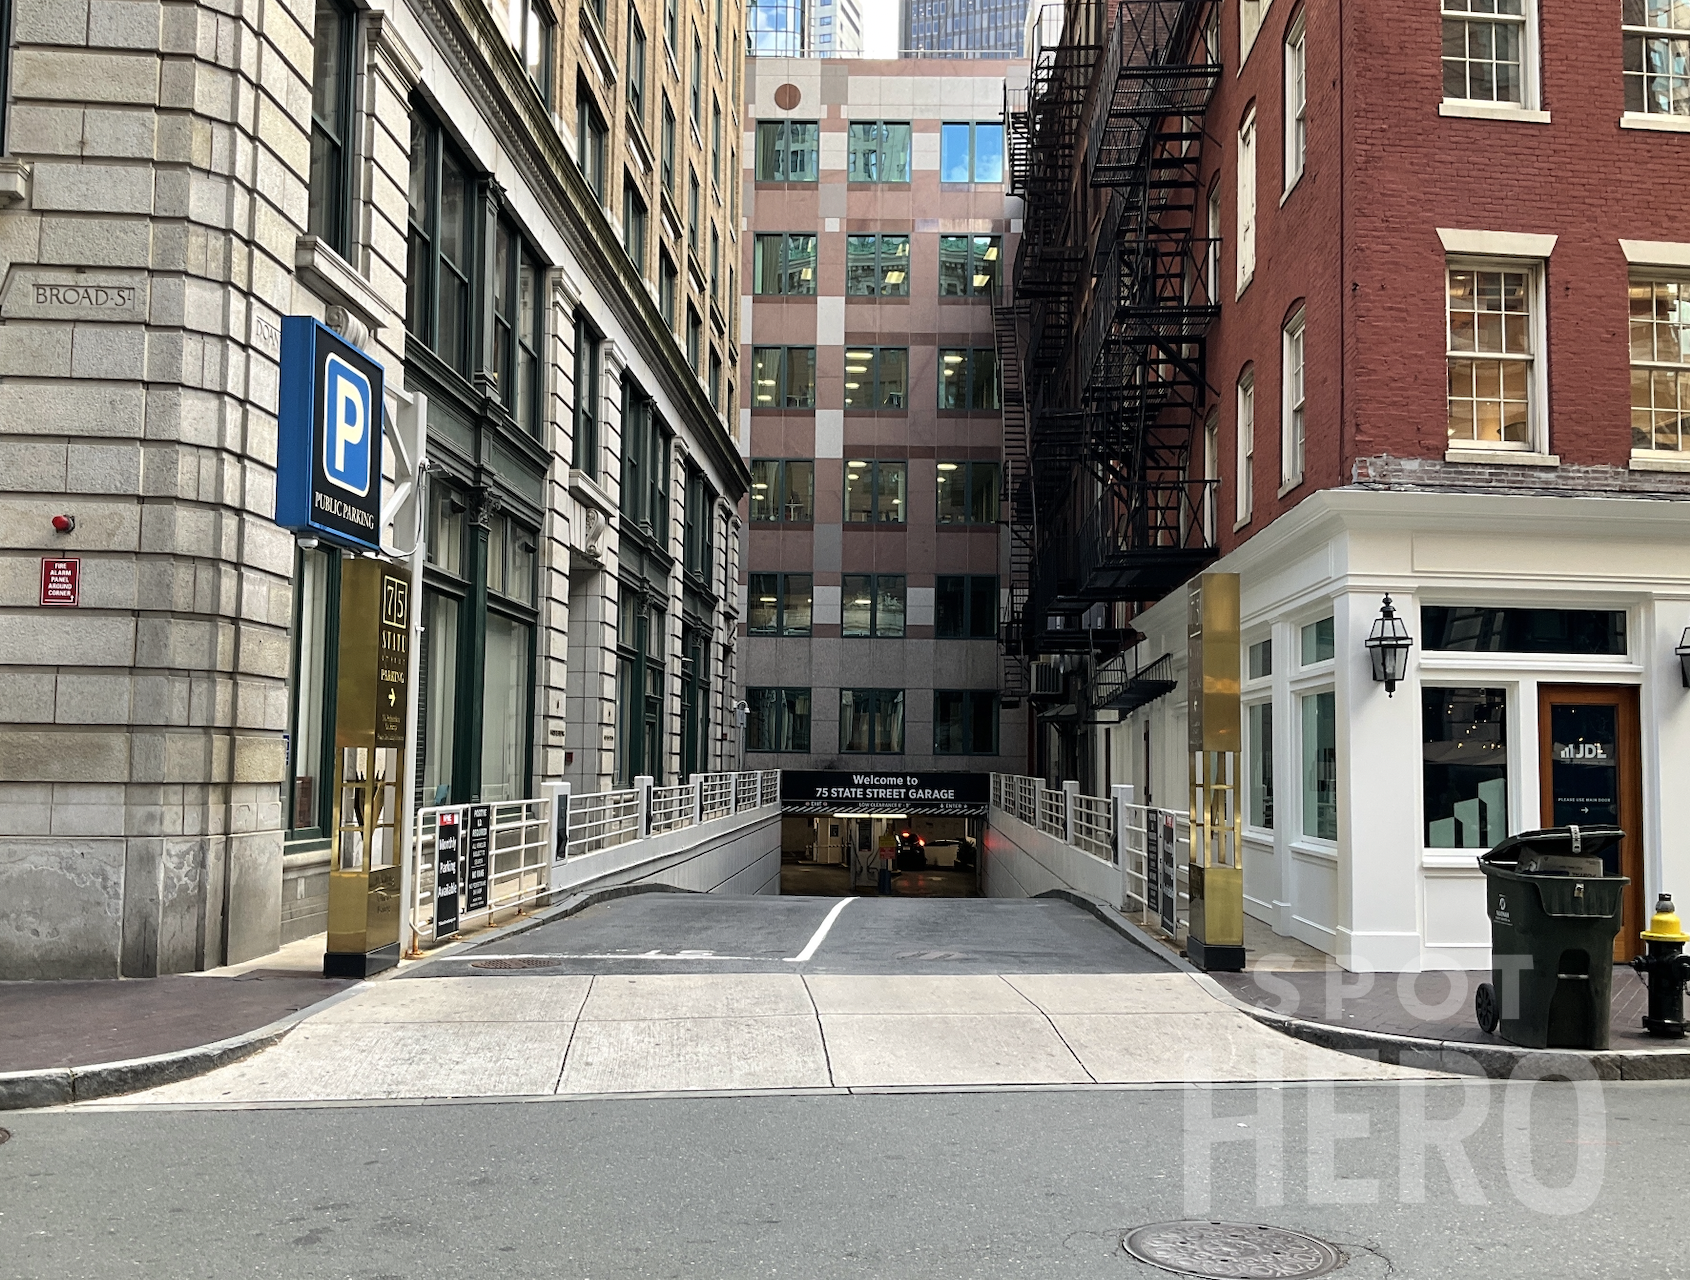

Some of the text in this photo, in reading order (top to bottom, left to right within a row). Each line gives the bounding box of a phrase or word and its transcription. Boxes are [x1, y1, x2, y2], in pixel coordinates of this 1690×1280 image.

[36, 287, 109, 306] BROAD
[335, 374, 364, 472] P
[314, 491, 375, 530] PUBLIC PARKING
[386, 585, 405, 619] 75
[381, 629, 406, 653] STATE
[380, 668, 405, 684] PARKING
[852, 774, 919, 786] Welcome to
[815, 787, 955, 800] 75 STATE STREET GARAGE
[439, 836, 457, 851] Monthly
[440, 860, 456, 874] Parking
[437, 882, 458, 898] Available
